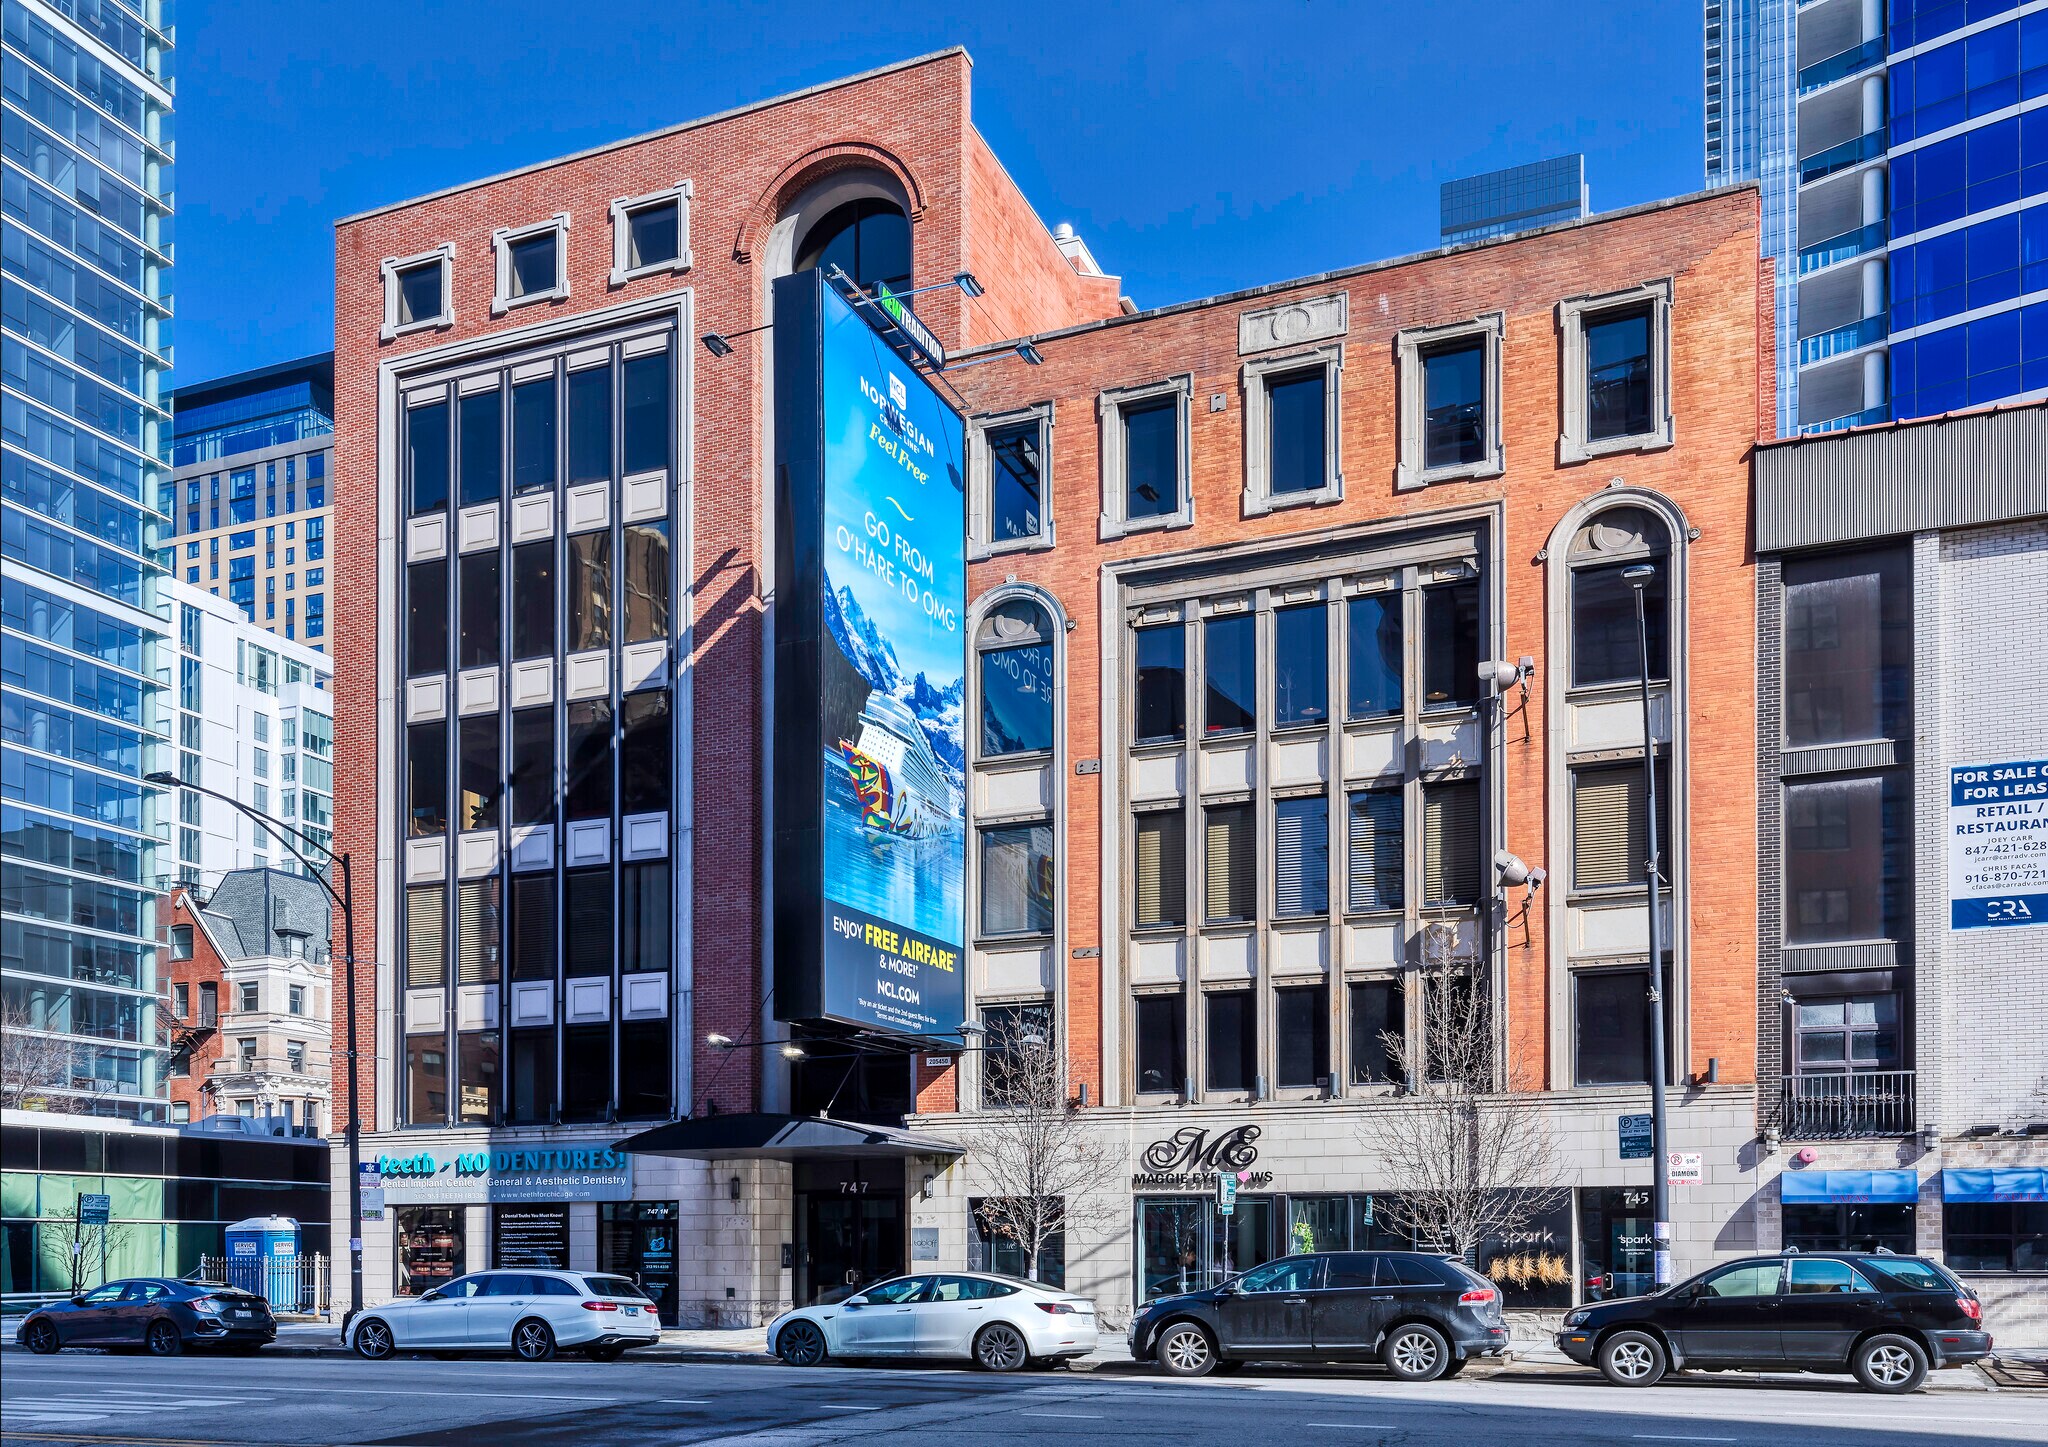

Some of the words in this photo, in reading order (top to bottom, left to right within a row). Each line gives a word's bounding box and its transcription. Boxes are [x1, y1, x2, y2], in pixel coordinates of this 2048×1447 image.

[860, 376, 934, 457] NORWEGIAN
[880, 413, 902, 440] CRUISE
[869, 422, 898, 459] Feel
[864, 511, 890, 547] GO
[895, 533, 934, 585] FROM
[837, 525, 895, 588] O'HARE
[900, 571, 918, 603] TO
[923, 591, 955, 632] OMG
[1953, 771, 1989, 784] FOR
[1993, 766, 2037, 780] SALE
[1964, 787, 2000, 800] FOR
[1976, 804, 2032, 818] RETAIL
[1974, 852, 2046, 863] jcarr@carradv.com
[1965, 869, 2046, 883] 916-870-721
[1971, 880, 2048, 890] cfacas@carradv.com
[1987, 899, 2032, 918] CRA
[833, 915, 863, 939] ENJOY
[865, 923, 899, 955] FREE
[880, 954, 887, 969] &
[877, 979, 920, 1005] NCL.COM
[878, 1002, 888, 1012] ticket
[908, 1012, 917, 1020] guest
[894, 1015, 912, 1027] conditions
[912, 1021, 922, 1030] apply
[1147, 1124, 1262, 1169] ME
[379, 1152, 437, 1174] teeth
[458, 1152, 491, 1173] NO
[495, 1148, 627, 1172] DENTURES!
[381, 1179, 408, 1188] Dental
[410, 1178, 442, 1189] Implant
[446, 1178, 476, 1188] Center
[487, 1177, 522, 1187] General
[525, 1177, 532, 1186] &
[535, 1176, 580, 1186] Aesthetic
[582, 1175, 627, 1187] Dentistry
[1133, 1173, 1189, 1184] MAGGIE
[500, 1191, 590, 1199] www.teethforchicagocom
[840, 1182, 869, 1194] 747
[1623, 1191, 1650, 1205] 745
[1831, 1194, 1869, 1202] TAPAS
[1995, 1192, 2044, 1201] PAELLA
[1619, 1233, 1652, 1247] spark
